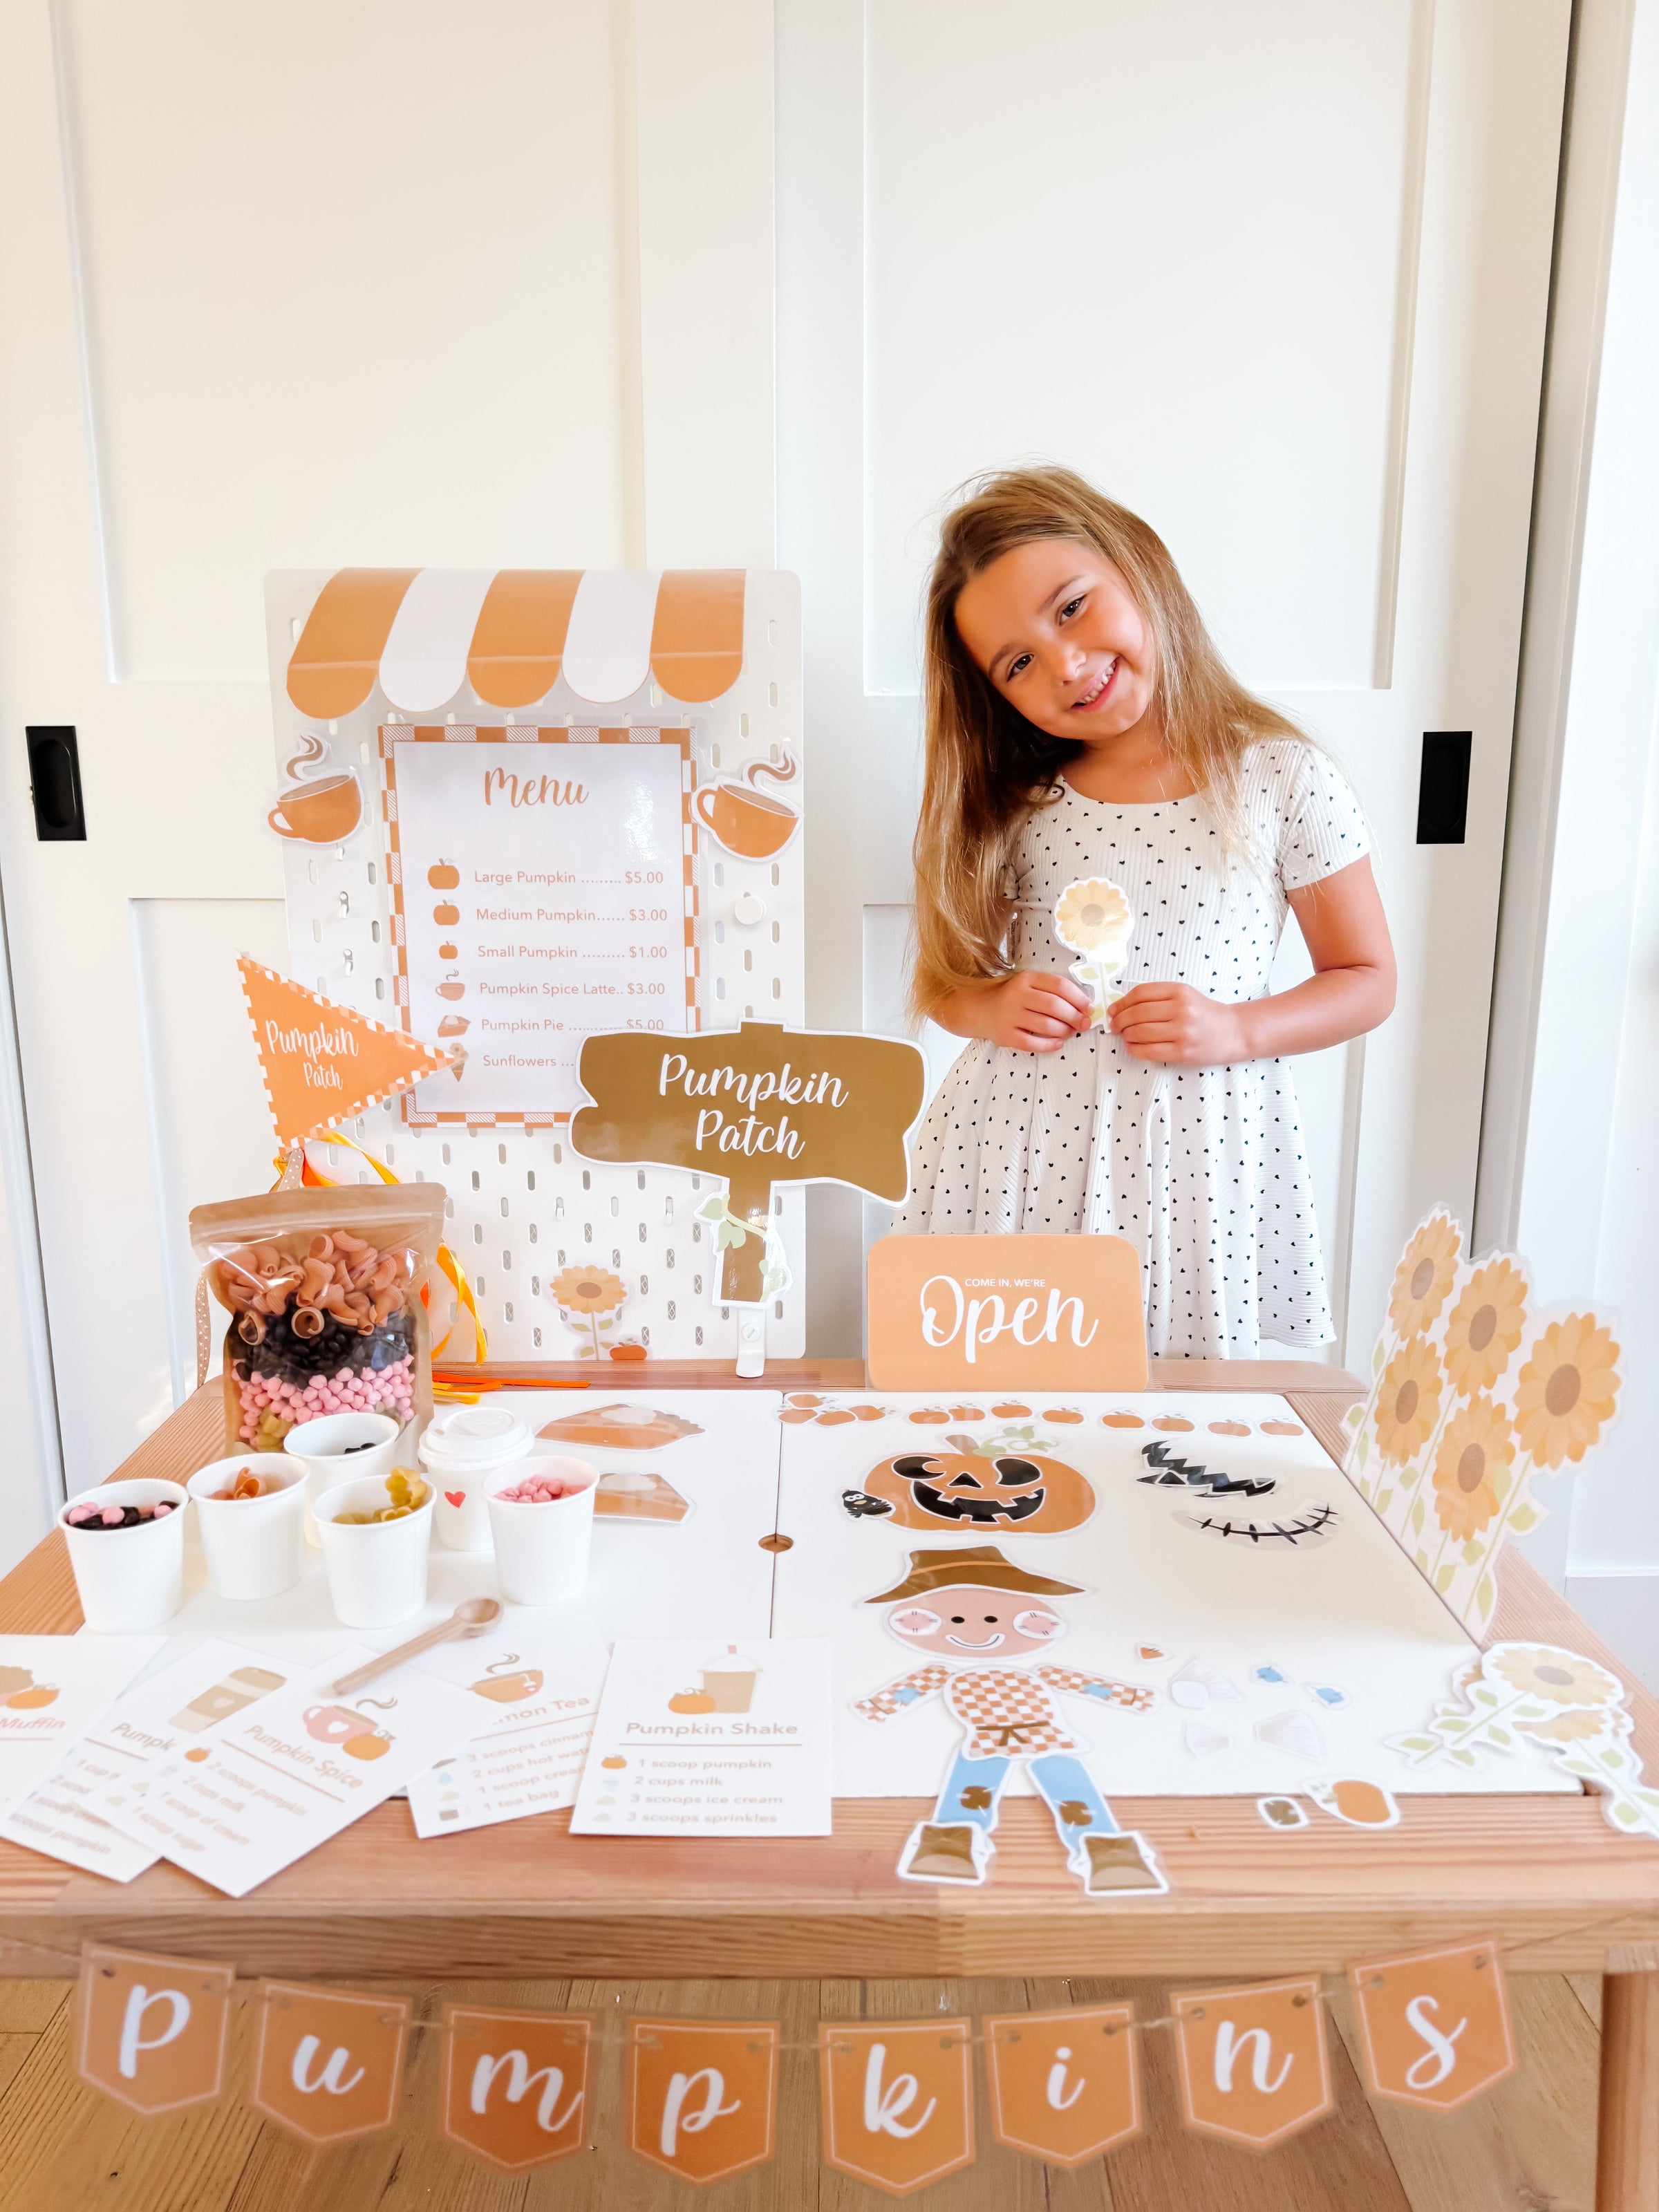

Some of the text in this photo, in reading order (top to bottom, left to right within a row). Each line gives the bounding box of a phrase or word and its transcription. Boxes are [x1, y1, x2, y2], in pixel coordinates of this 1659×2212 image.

[484, 767, 590, 809] Menu
[474, 871, 664, 886] Large Pumpkin $5.00
[476, 909, 532, 921] Medium
[629, 910, 668, 921] $3.00
[478, 946, 667, 961] Small Pumpkin $1.00
[479, 983, 538, 997] Pumpkin
[543, 982, 580, 997] Spice
[627, 983, 665, 995] $3.00
[481, 1019, 540, 1033] Pumpkin
[543, 1018, 564, 1031] Pie
[265, 1020, 359, 1064] Pumpkin
[482, 1055, 557, 1067] Sunflowers
[303, 1062, 344, 1091] Patch
[659, 1053, 849, 1112] Pumpkin
[695, 1109, 806, 1160] Patch
[964, 1278, 1046, 1288] COME IN, WE'RE
[919, 1275, 1099, 1363] Open
[551, 1697, 590, 1711] Tea
[626, 1722, 798, 1738] Pumpkin Shake
[245, 1725, 363, 1789] Pumpkin Spice
[469, 1752, 477, 1762] 3
[482, 1743, 536, 1760] scoops
[473, 1770, 482, 1779] 2
[487, 1762, 525, 1774] cups
[527, 1755, 554, 1766] hot
[651, 1761, 698, 1770] scoop
[702, 1759, 772, 1770] pumpkin
[479, 1785, 486, 1794] 1
[492, 1776, 540, 1792] scoop
[634, 1776, 724, 1788] 2 cups milk
[252, 1787, 307, 1816] pumpkin
[485, 1790, 561, 1811] 1 tea bag
[630, 1793, 783, 1806] 3 scoops ice cream
[626, 1812, 778, 1824] 3 scoops sprinkles
